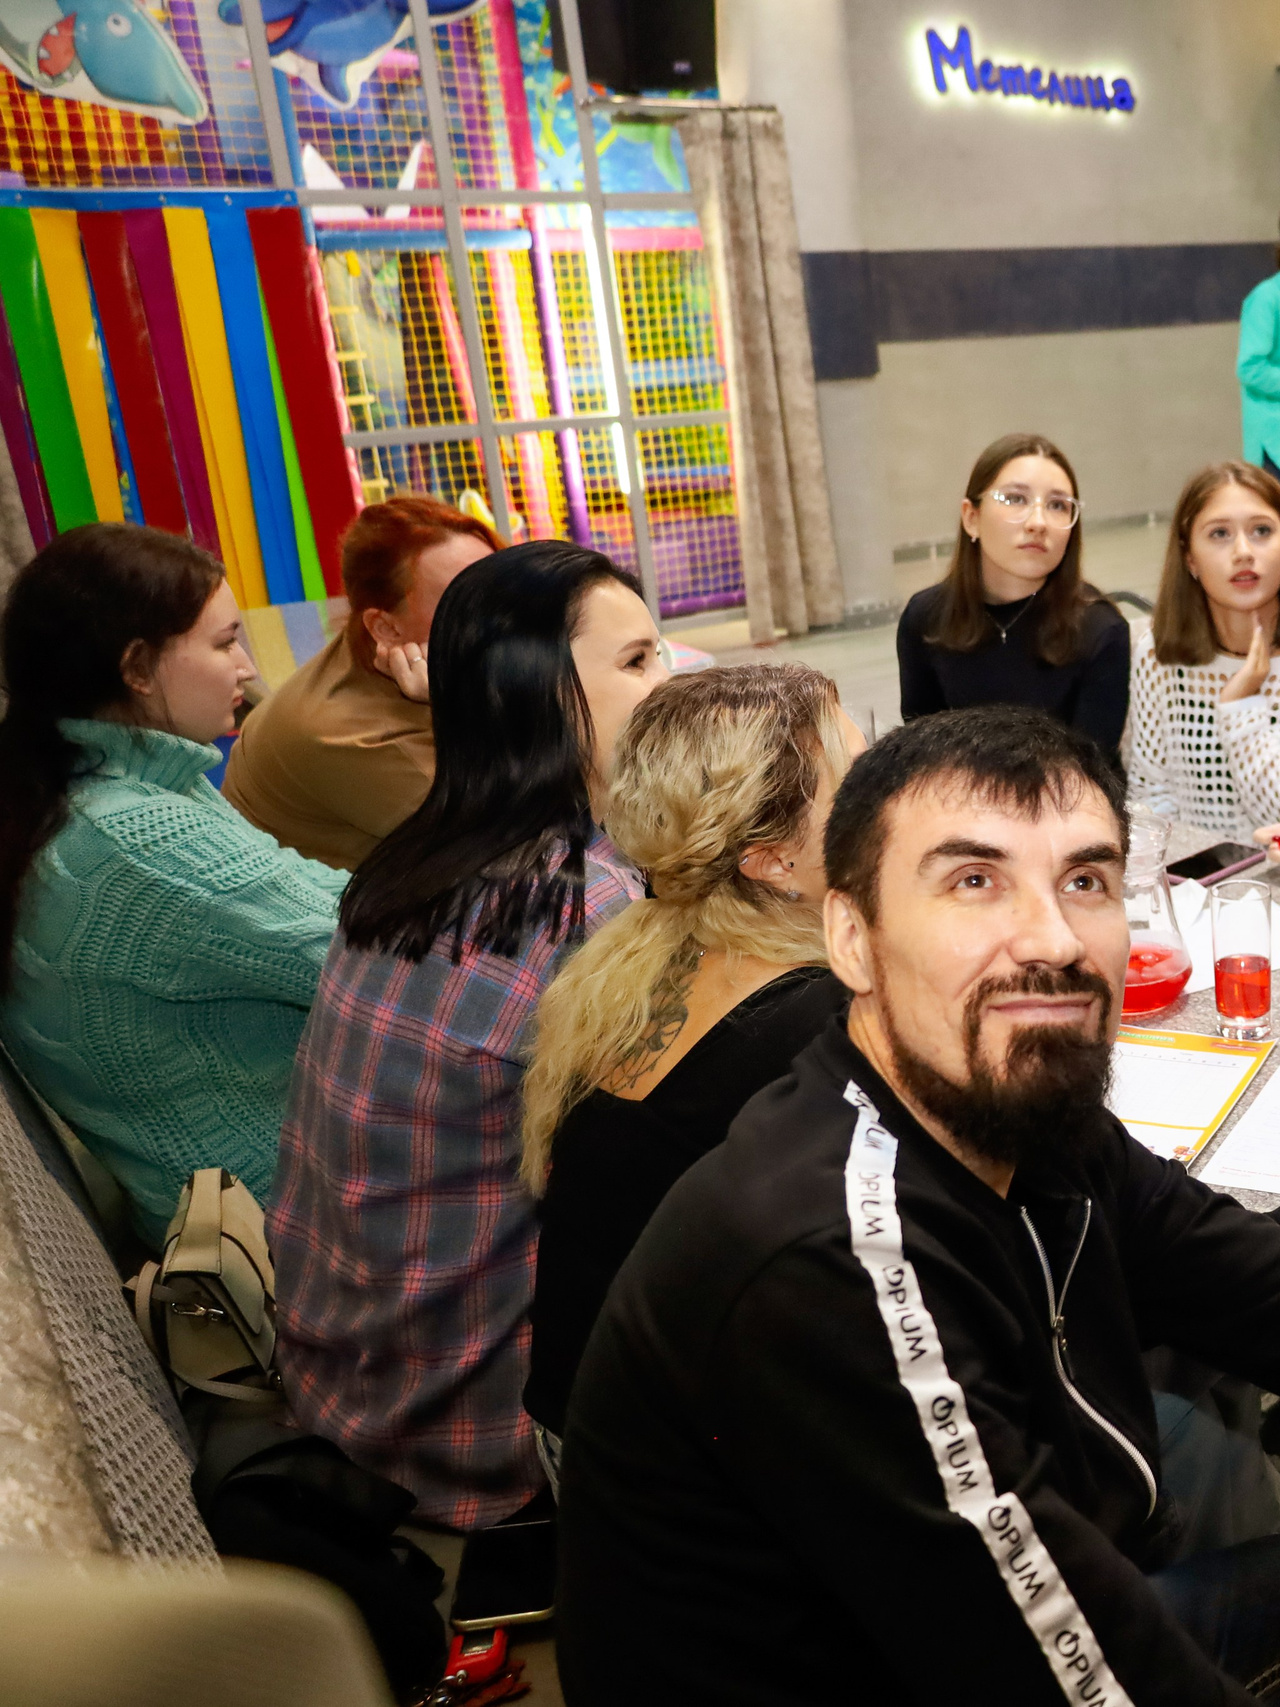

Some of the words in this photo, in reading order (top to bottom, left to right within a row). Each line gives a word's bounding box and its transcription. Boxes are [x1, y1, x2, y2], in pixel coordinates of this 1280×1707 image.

[926, 25, 1136, 113] Метелица
[882, 1264, 927, 1362] OPIUM
[931, 1395, 978, 1494] OPIUM
[987, 1505, 1045, 1600] OPIUM
